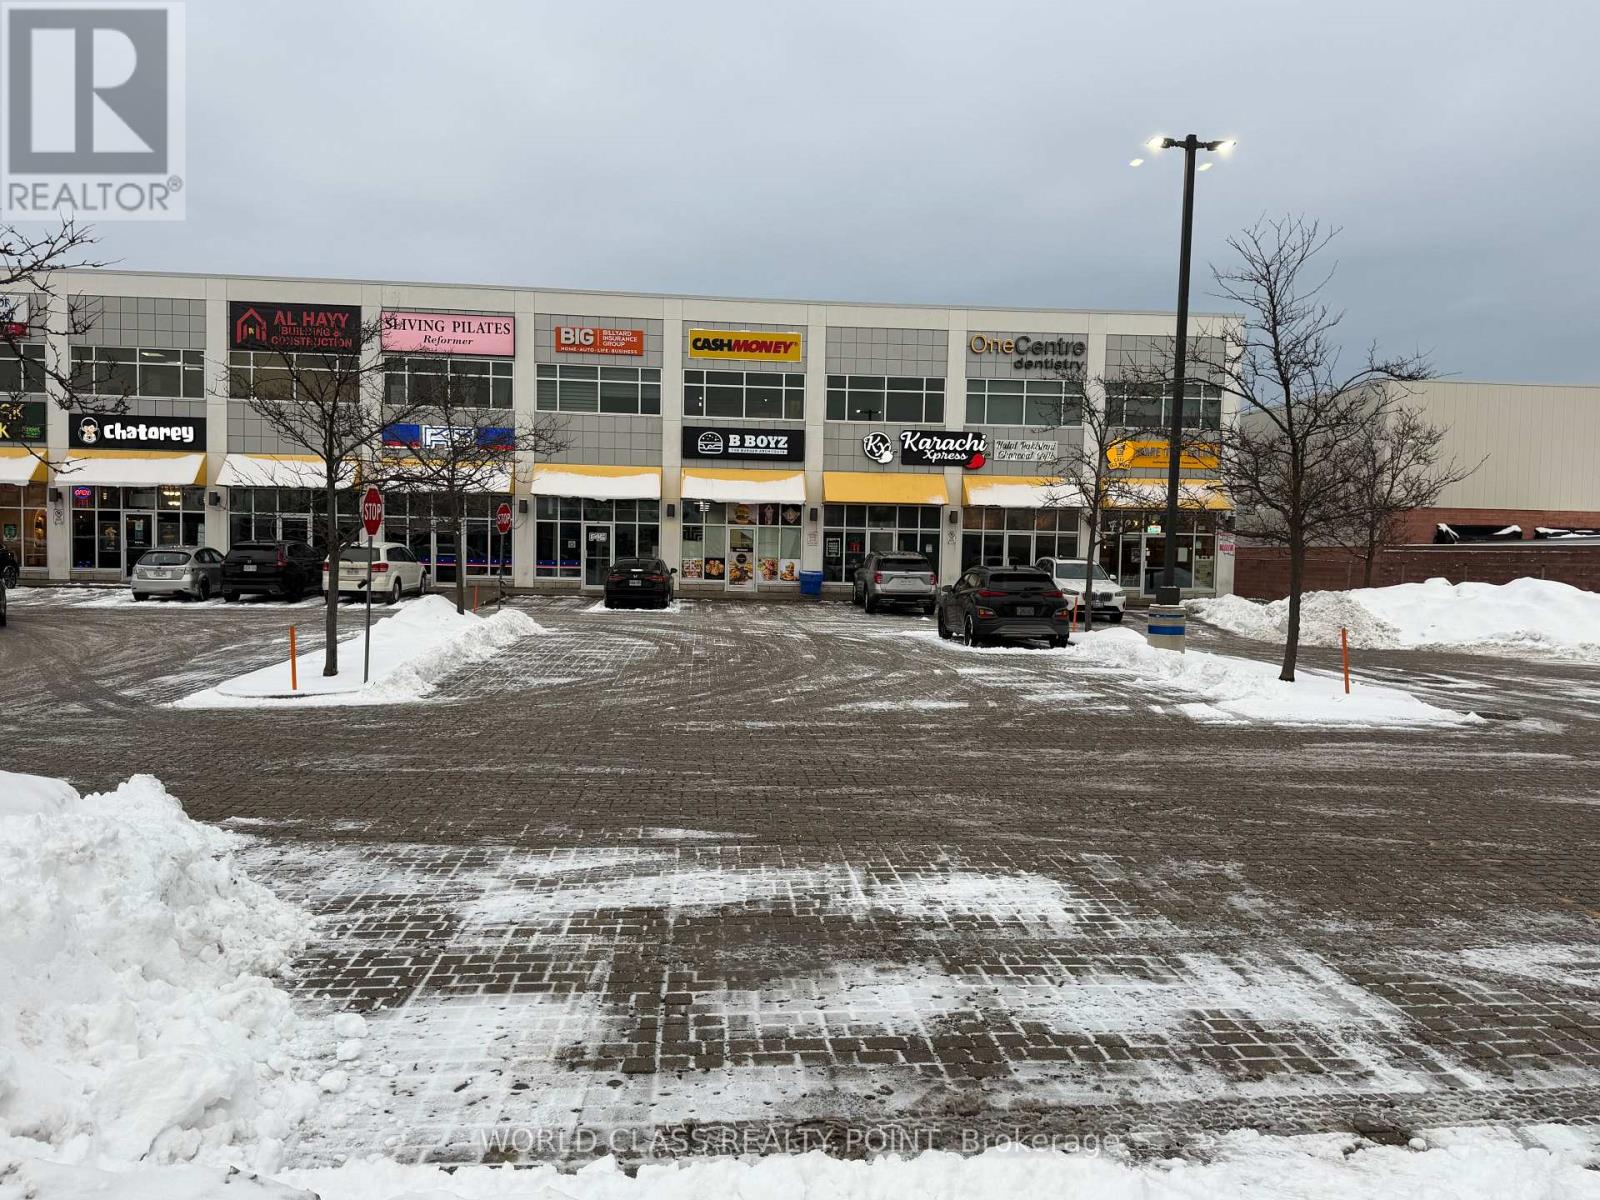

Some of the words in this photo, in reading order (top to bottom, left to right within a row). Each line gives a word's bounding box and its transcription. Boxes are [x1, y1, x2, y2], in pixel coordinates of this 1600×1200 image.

[273, 310, 297, 326] AL
[303, 311, 349, 328] HAYY
[452, 320, 511, 335] PILATES
[602, 329, 632, 337] BILLYARD
[423, 334, 474, 346] Reformer
[560, 327, 594, 346] BIG
[602, 335, 638, 343] INSURANCE
[1013, 358, 1084, 371] dentistry
[103, 422, 194, 443] Chatorey
[729, 434, 741, 447] B
[744, 435, 788, 448] BOYZ
[900, 431, 988, 452] Karachi
[922, 449, 969, 463] Xpress
[364, 503, 381, 521] STOP
[498, 513, 512, 525] STOP
